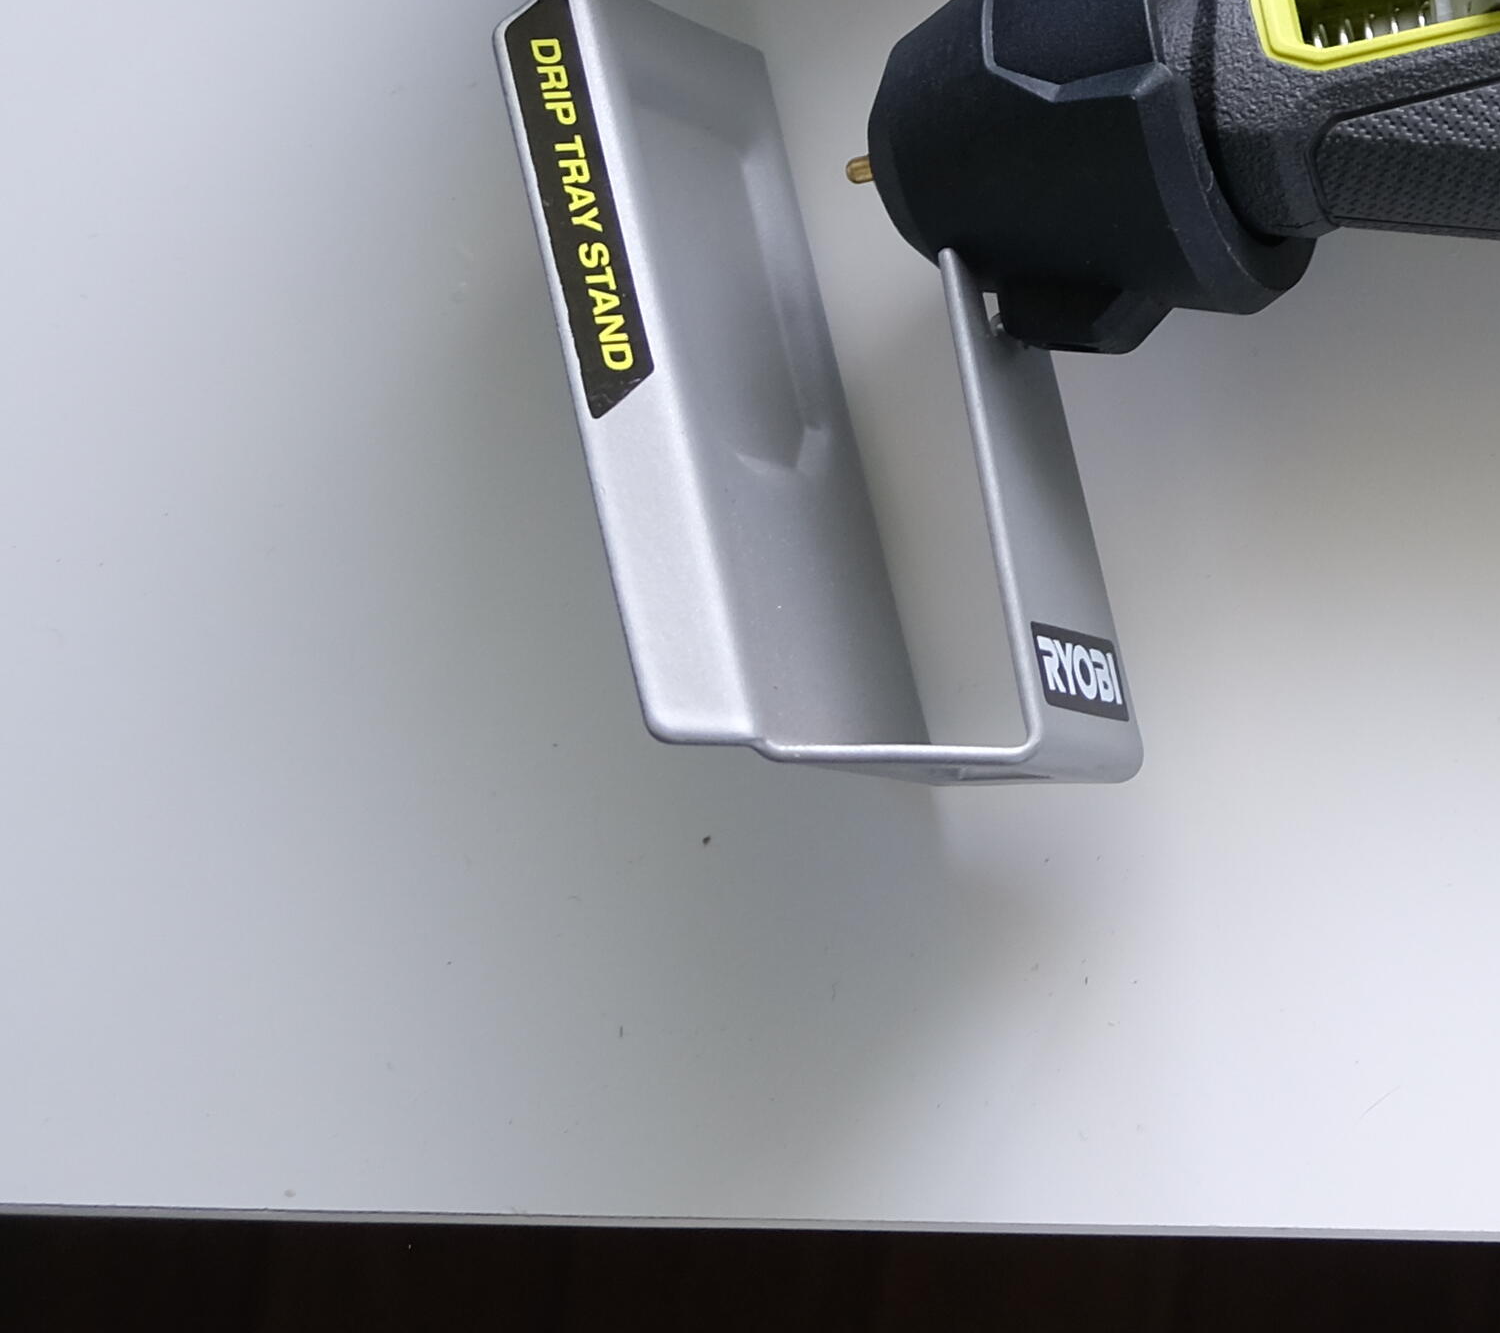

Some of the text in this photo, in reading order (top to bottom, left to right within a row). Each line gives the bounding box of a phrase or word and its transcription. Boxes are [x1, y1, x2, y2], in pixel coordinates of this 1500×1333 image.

[530, 37, 635, 371] DRIP TRAY STAND
[1036, 635, 1122, 705] RYOBI
